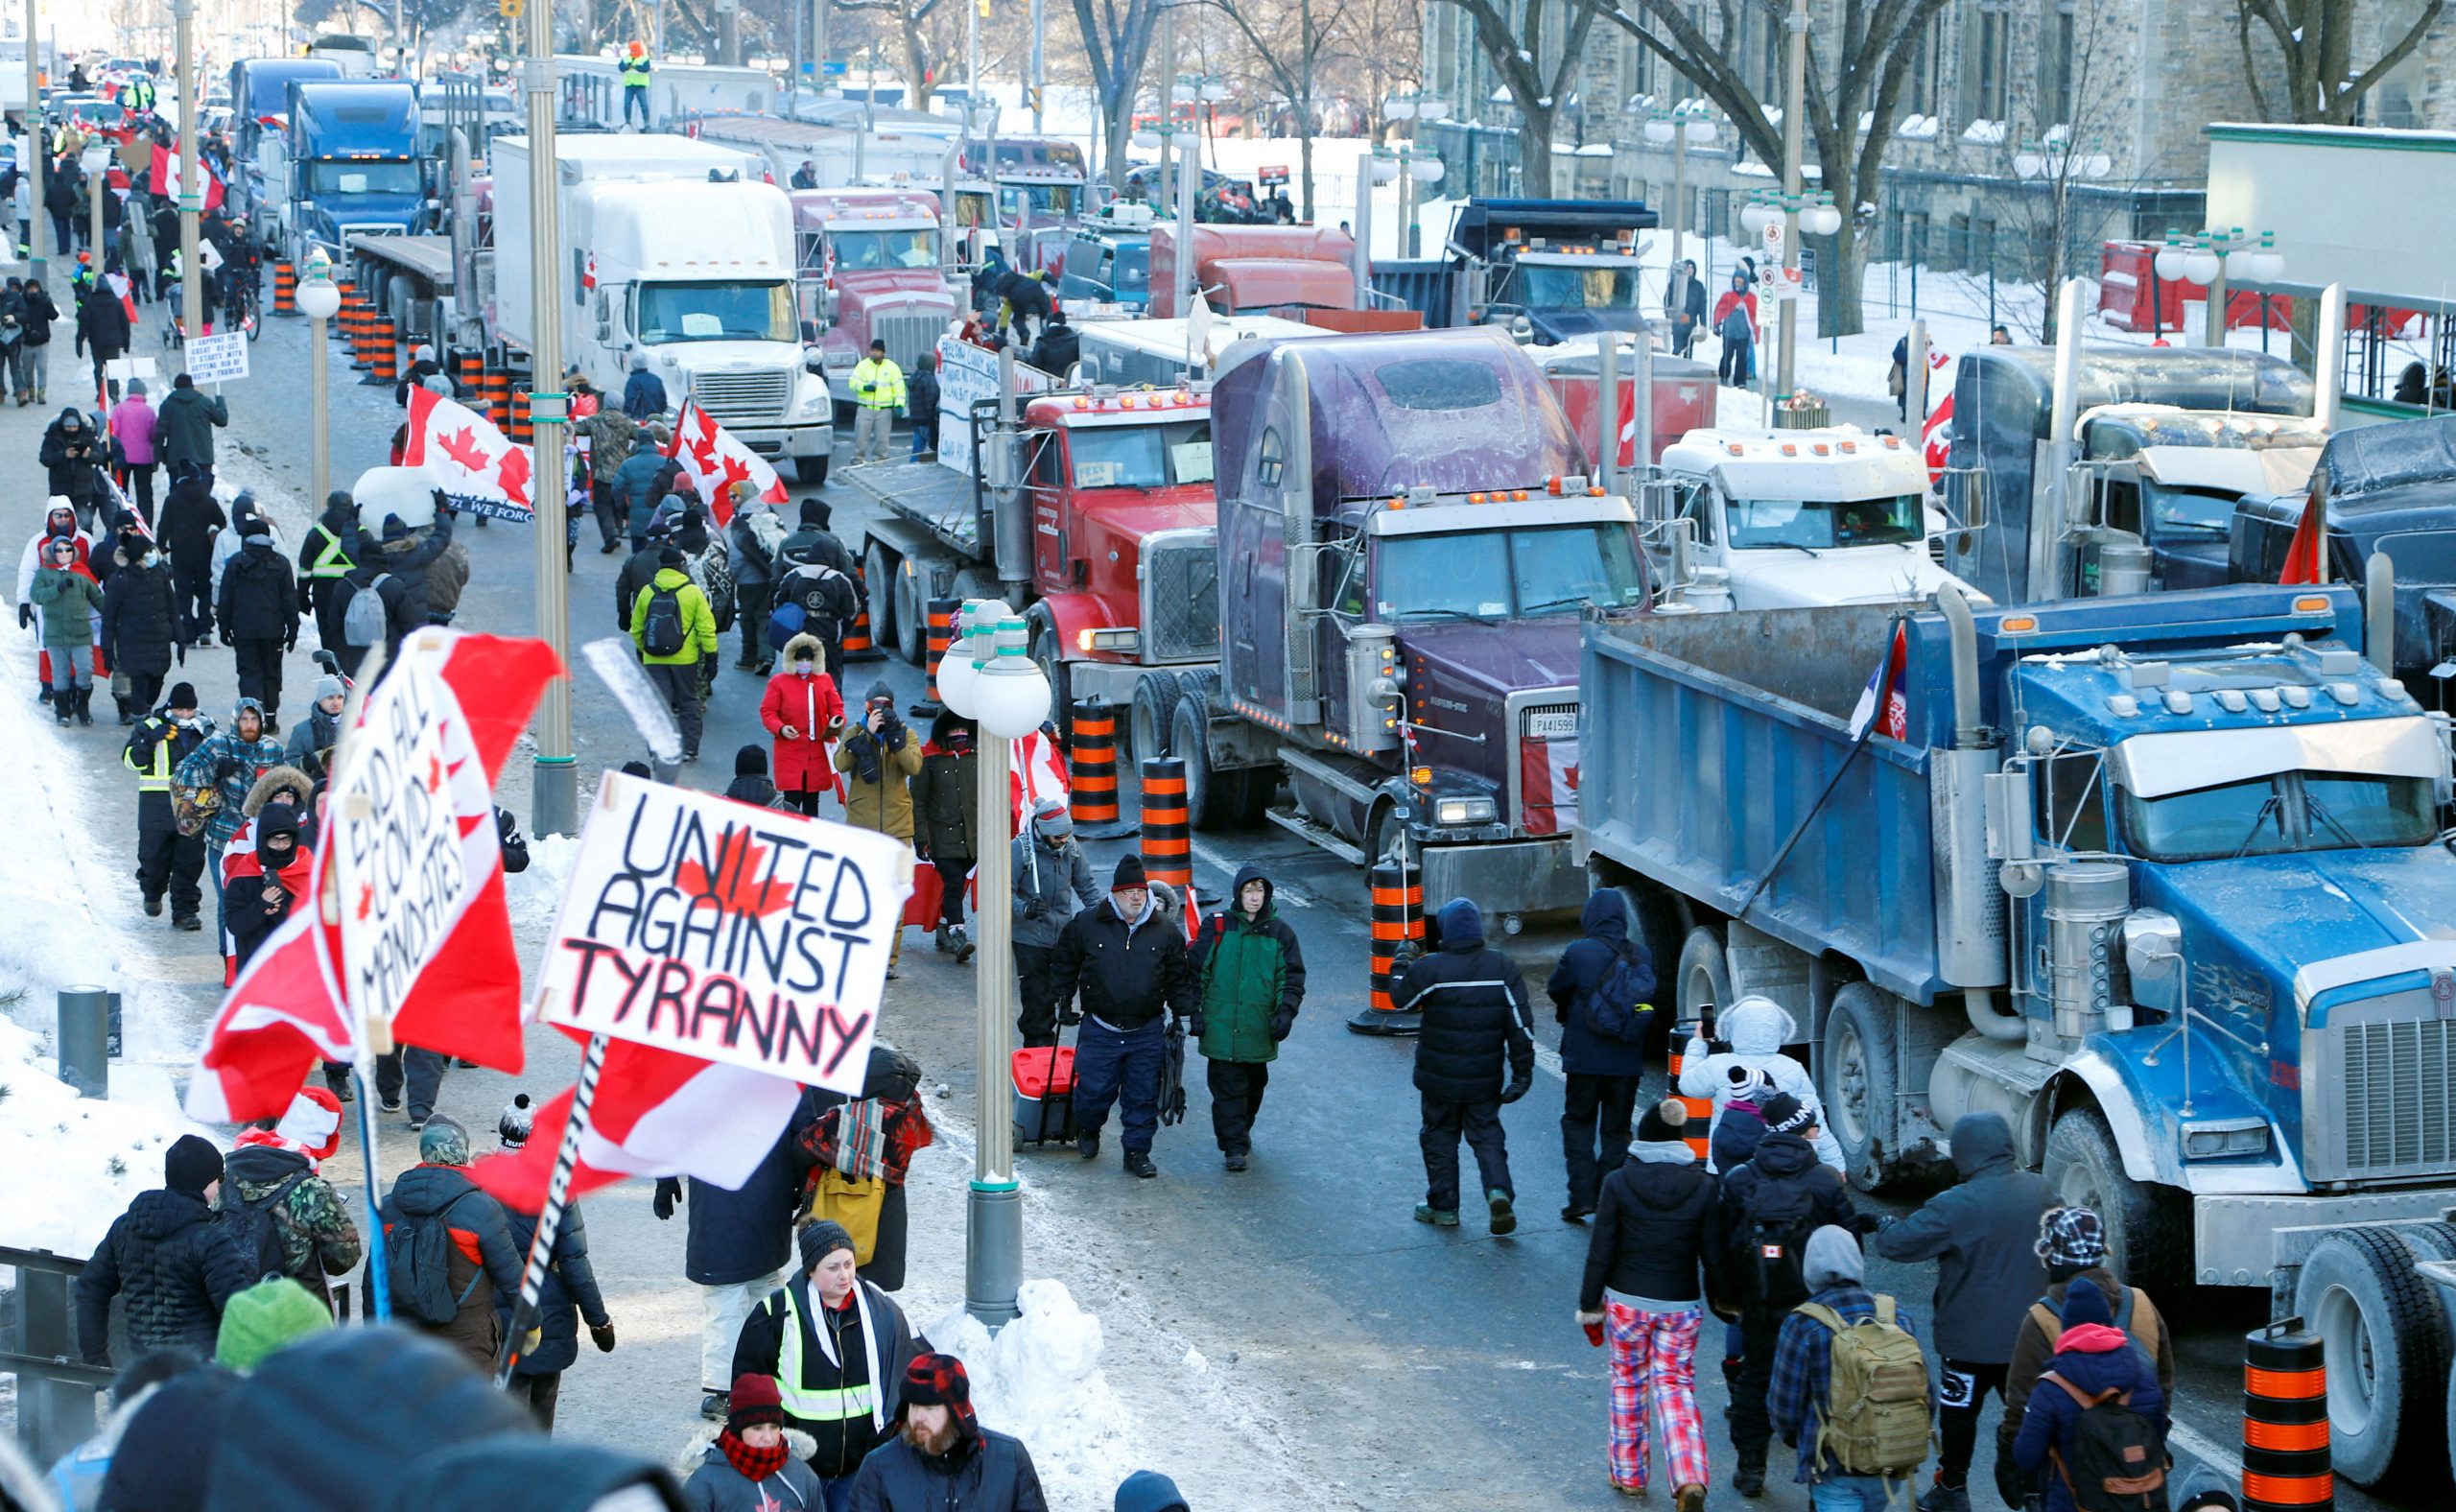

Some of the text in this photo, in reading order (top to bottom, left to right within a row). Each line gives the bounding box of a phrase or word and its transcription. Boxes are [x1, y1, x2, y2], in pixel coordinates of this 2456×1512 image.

[192, 370, 212, 381] USTIN
[470, 500, 493, 516] WE
[495, 506, 535, 523] FORG
[390, 664, 431, 780] ALL
[1537, 720, 1574, 732] PA41599
[372, 773, 432, 923] COVID
[624, 792, 872, 931] UNITED
[362, 814, 463, 1015] MANDATES
[587, 872, 872, 1003] AGAINST
[563, 936, 873, 1078] TYRANNY
[2232, 985, 2272, 1009] KENWORTH
